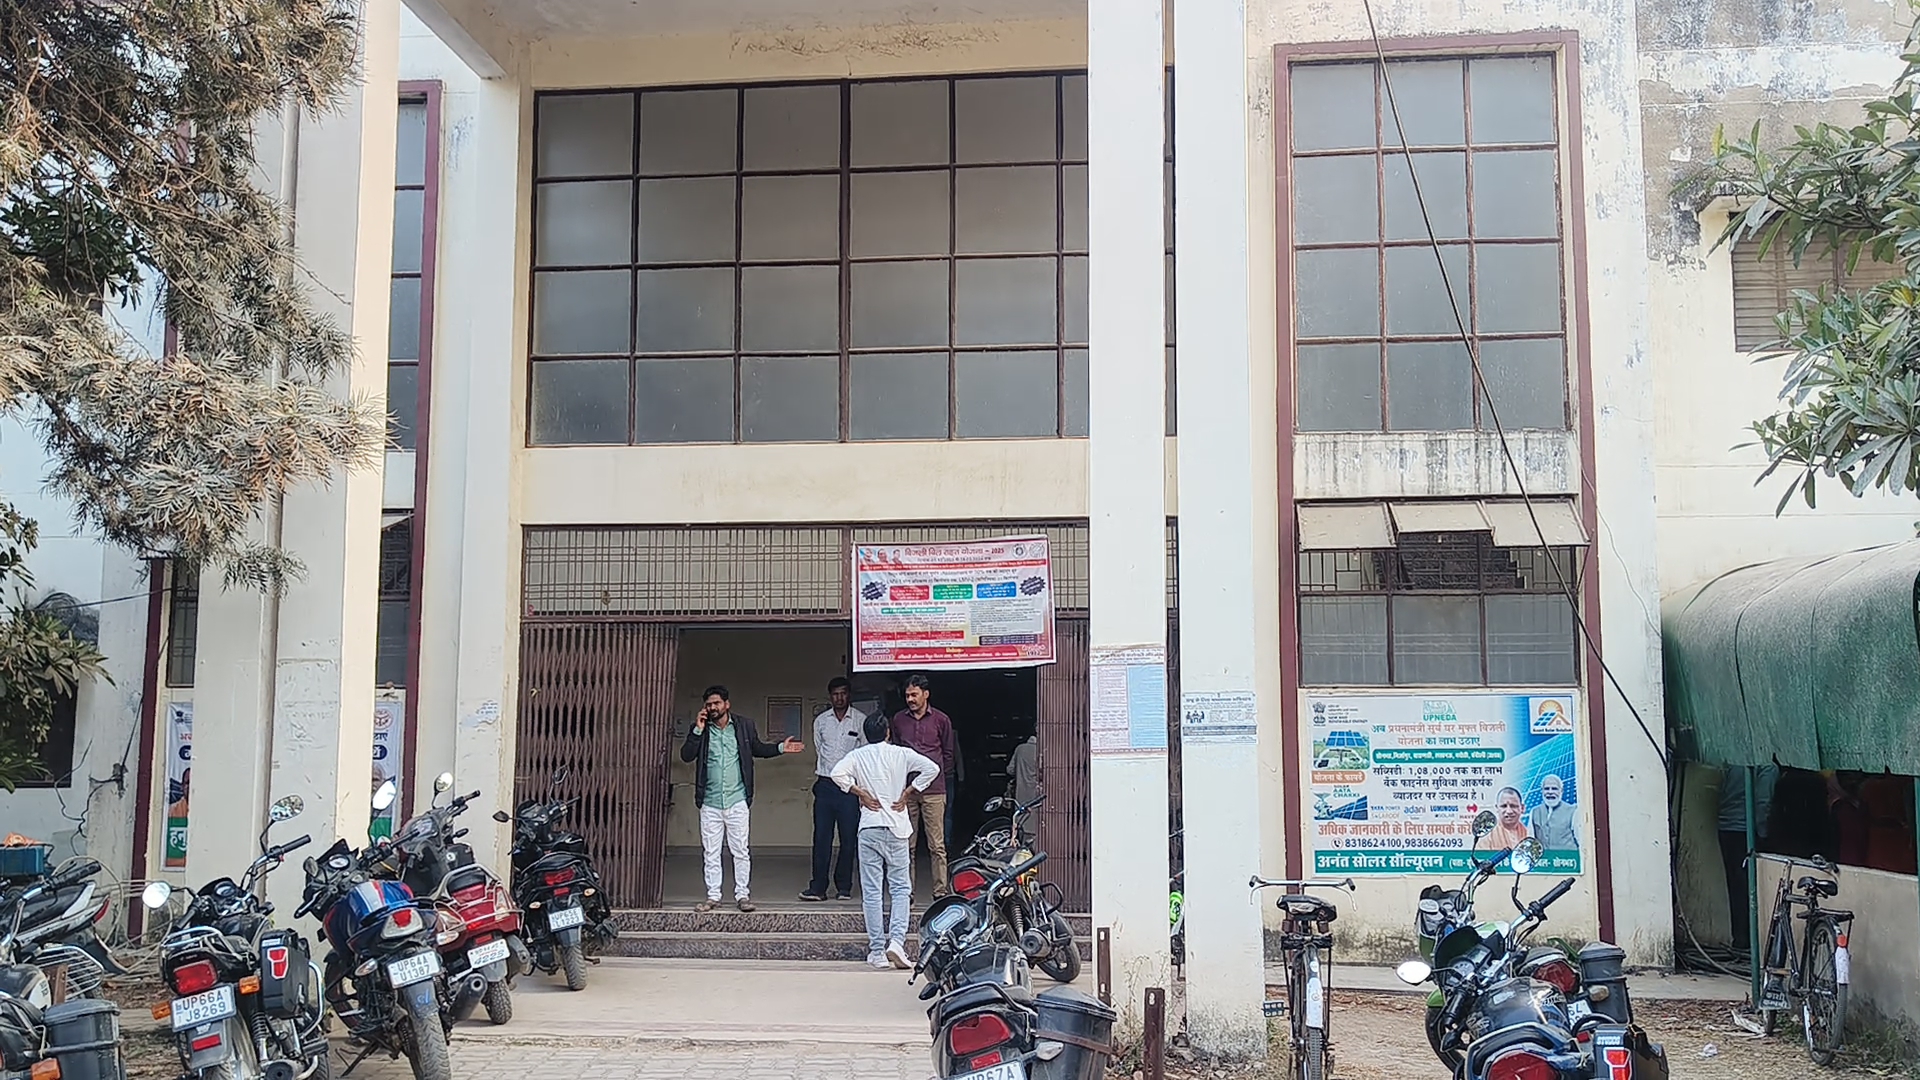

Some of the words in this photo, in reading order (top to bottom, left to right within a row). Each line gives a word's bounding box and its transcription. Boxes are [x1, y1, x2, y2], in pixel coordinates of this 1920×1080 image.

[1372, 724, 1386, 733] अब
[1479, 721, 1506, 732] बिजली
[1398, 735, 1423, 746] योजना
[1426, 737, 1437, 745] का
[1439, 737, 1457, 745] लाभ
[1453, 767, 1468, 775] तक
[1471, 767, 1482, 775] का
[1484, 767, 1503, 775] लाभ
[1432, 776, 1458, 790] सुविधा
[1461, 776, 1493, 787] आकर्षक
[1425, 792, 1436, 800] पर
[1404, 804, 1426, 814] adani
[1318, 821, 1347, 835] अधिक
[1350, 821, 1390, 835] जानकारी
[1392, 821, 1402, 835] के
[1404, 821, 1424, 835] लिए
[1426, 821, 1456, 835] सम्पर्क
[1345, 837, 1463, 848] 8318624100,9838662093
[1317, 853, 1350, 868] अनंत
[1352, 852, 1387, 868] सोलर
[397, 956, 429, 972] UP64A
[400, 964, 431, 981] U1387
[182, 990, 223, 1010] UP66A
[186, 1001, 226, 1022] J8269
[967, 1065, 1015, 1080] 67A
